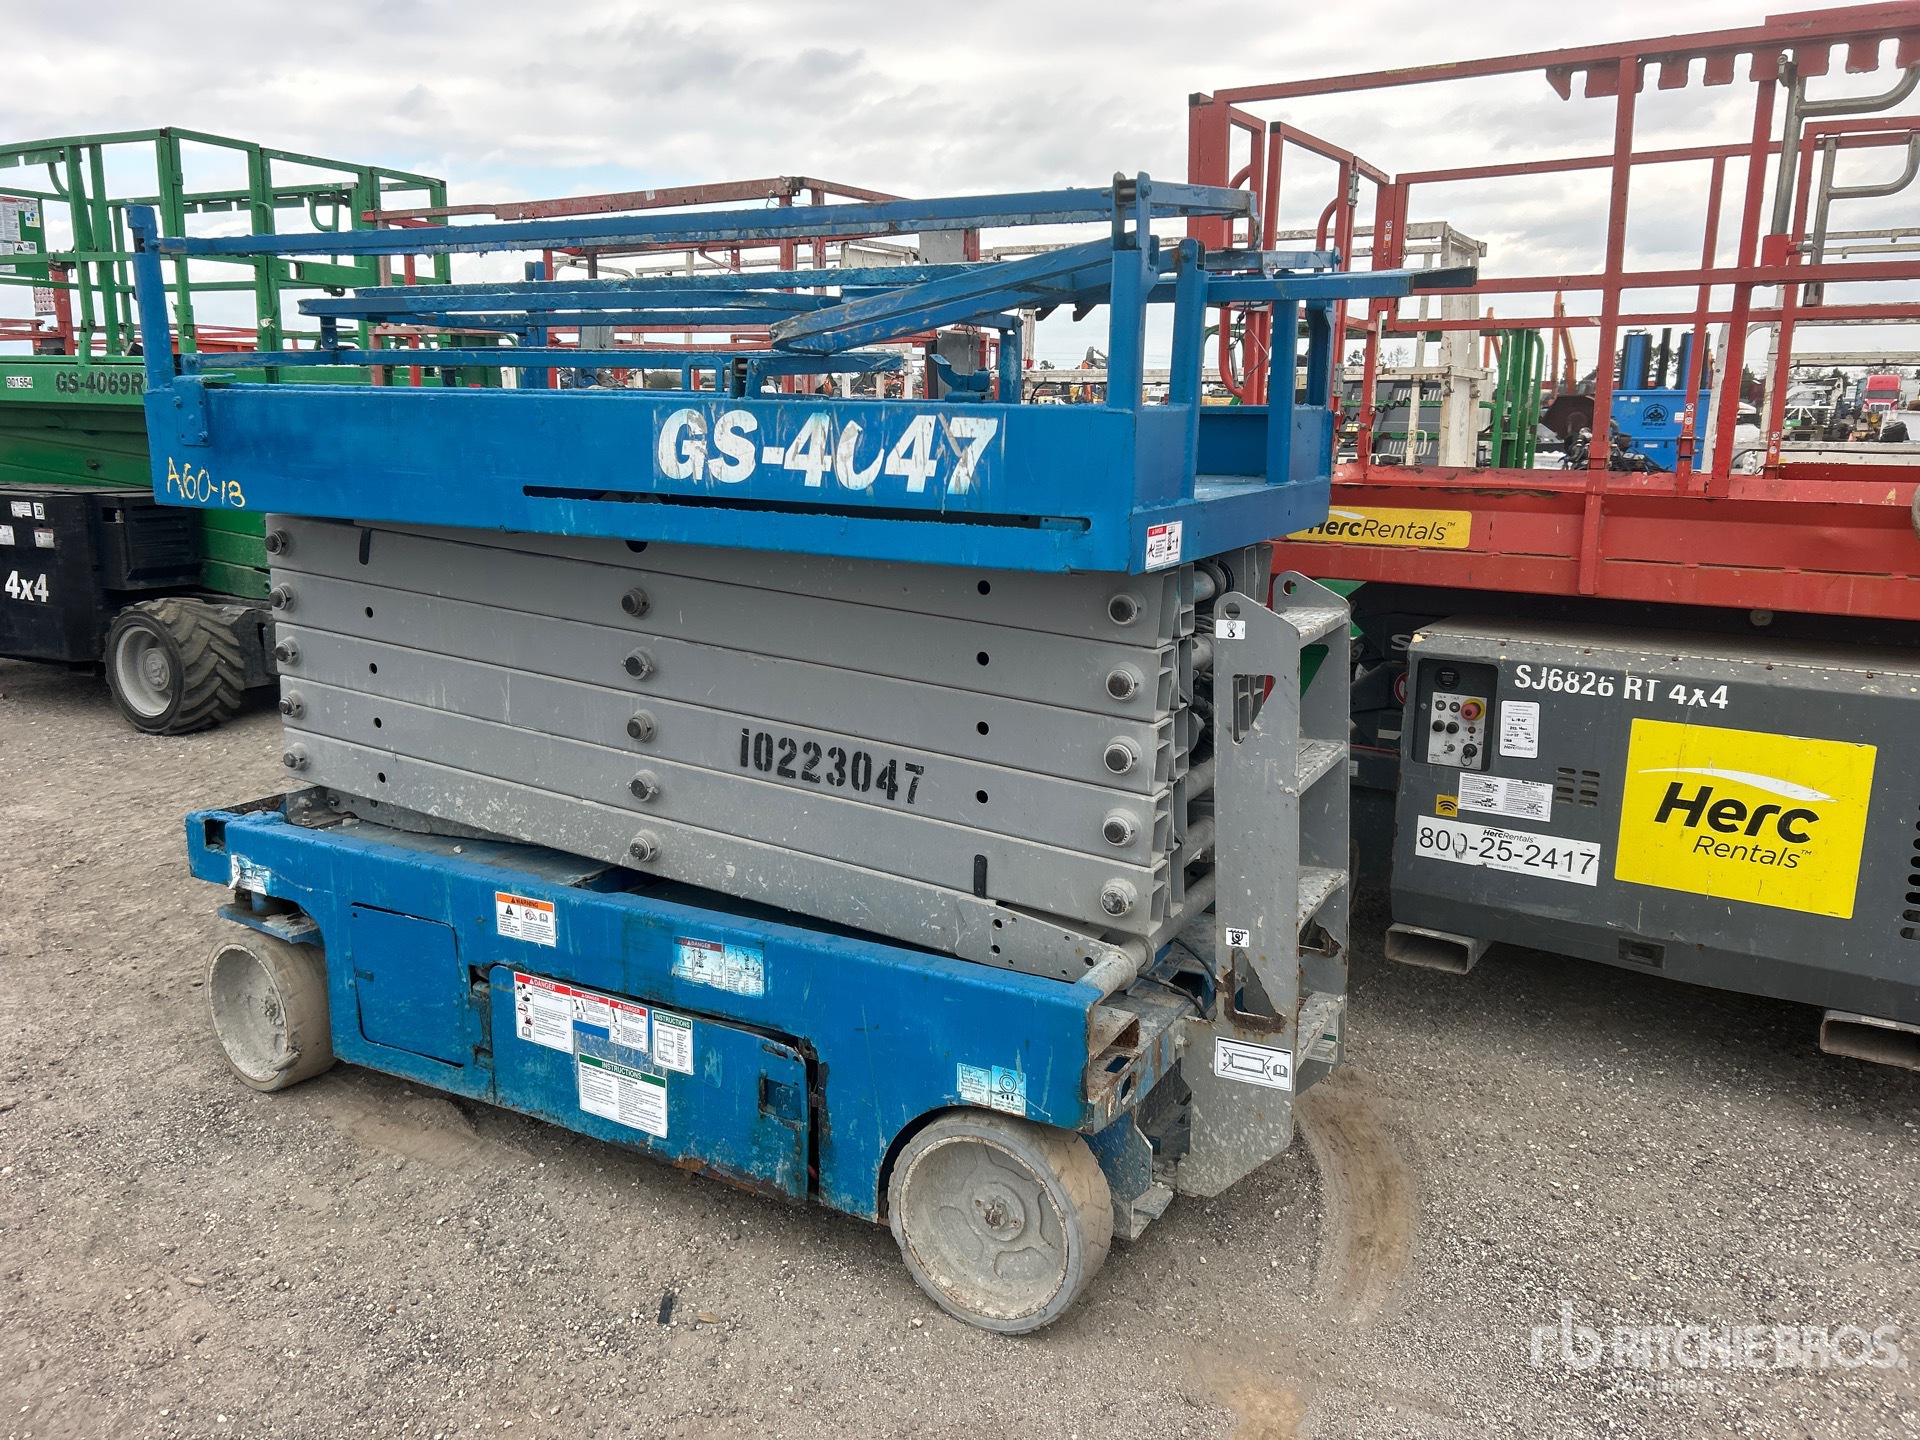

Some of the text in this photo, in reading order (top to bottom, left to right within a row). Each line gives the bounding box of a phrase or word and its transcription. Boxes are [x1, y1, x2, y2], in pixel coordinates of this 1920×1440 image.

[6, 377, 33, 388] 901554
[55, 371, 147, 396] GS-4069R
[167, 456, 246, 508] A60-18
[5, 570, 49, 603] 4x4
[1514, 664, 1729, 710] SJ6826 RT 4x4
[1654, 781, 1820, 844] Herc
[1419, 826, 1596, 875] 800-25-2417
[515, 898, 539, 909] WARNING
[690, 940, 711, 949] DANGER
[533, 979, 556, 992] DANGER
[584, 994, 600, 1002] DANGER
[622, 1005, 641, 1015] DANGER
[654, 1014, 691, 1029] INSTRUCTIONS
[601, 1061, 642, 1080] INSTRUCTIONS
